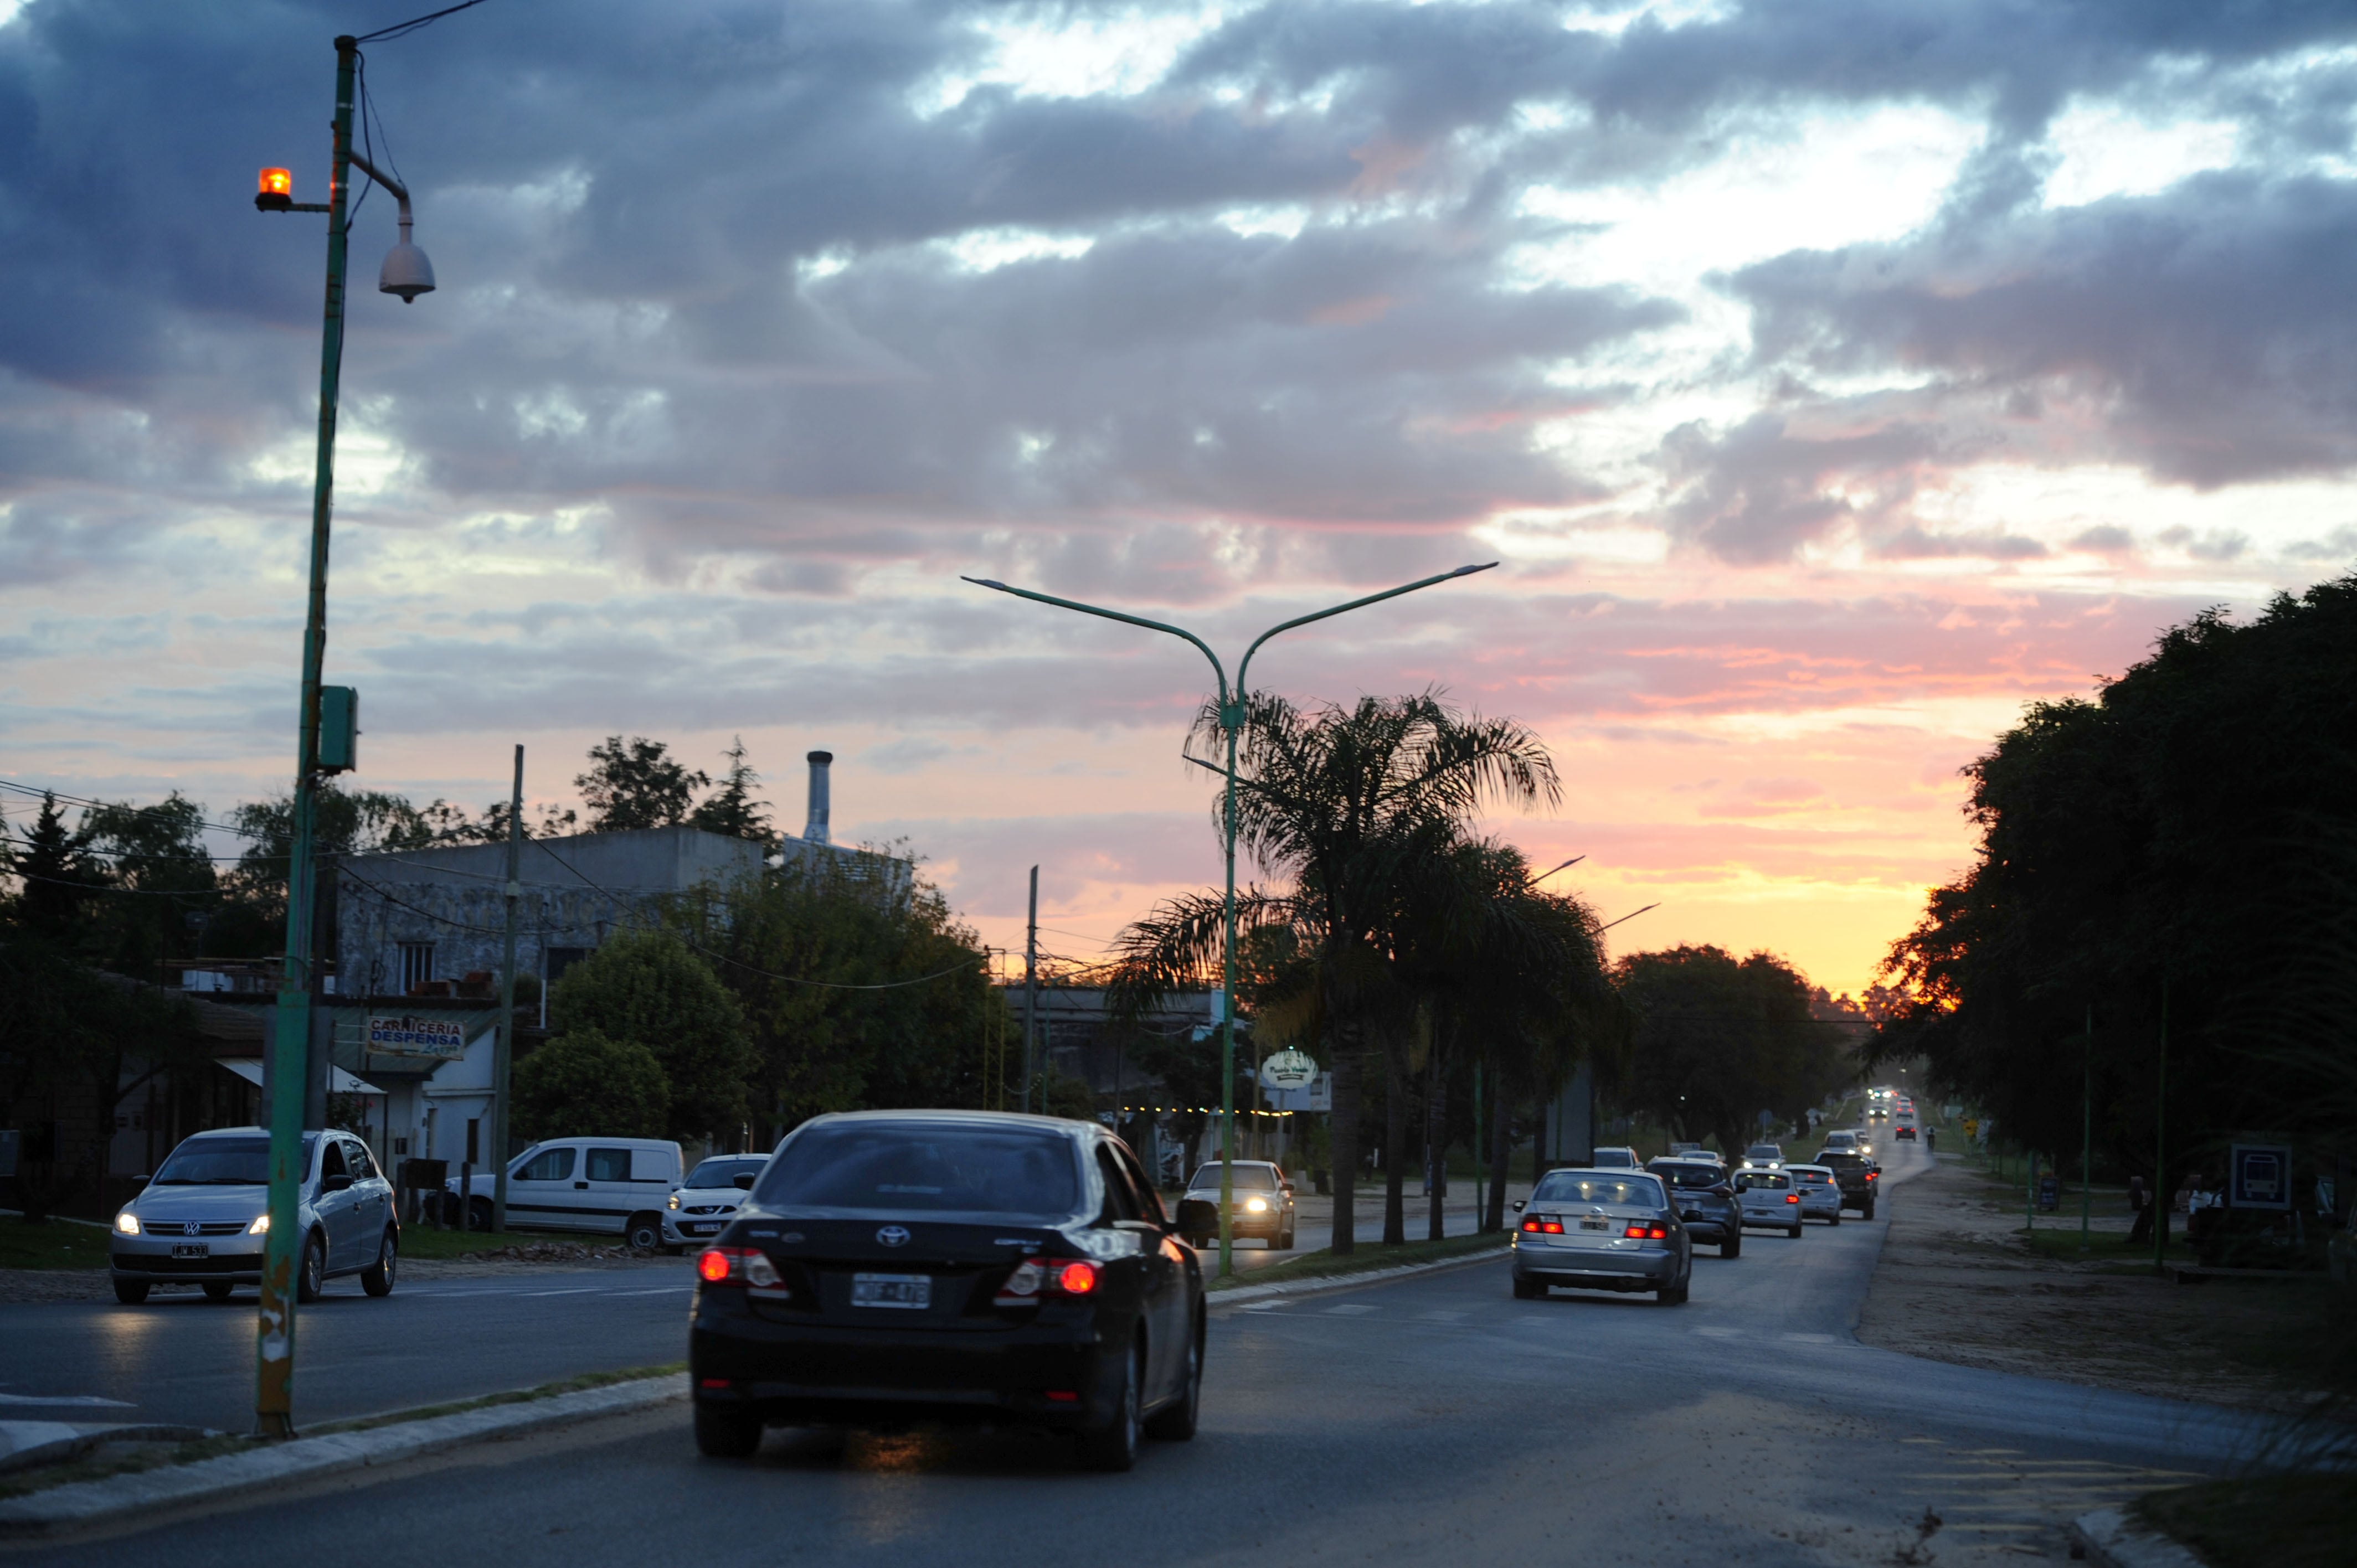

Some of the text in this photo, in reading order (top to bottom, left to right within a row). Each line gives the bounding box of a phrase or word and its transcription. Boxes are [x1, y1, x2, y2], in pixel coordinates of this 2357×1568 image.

[372, 1020, 460, 1035] CARNICERIA
[372, 1030, 461, 1046] DESPENSA
[192, 1246, 207, 1255] 533
